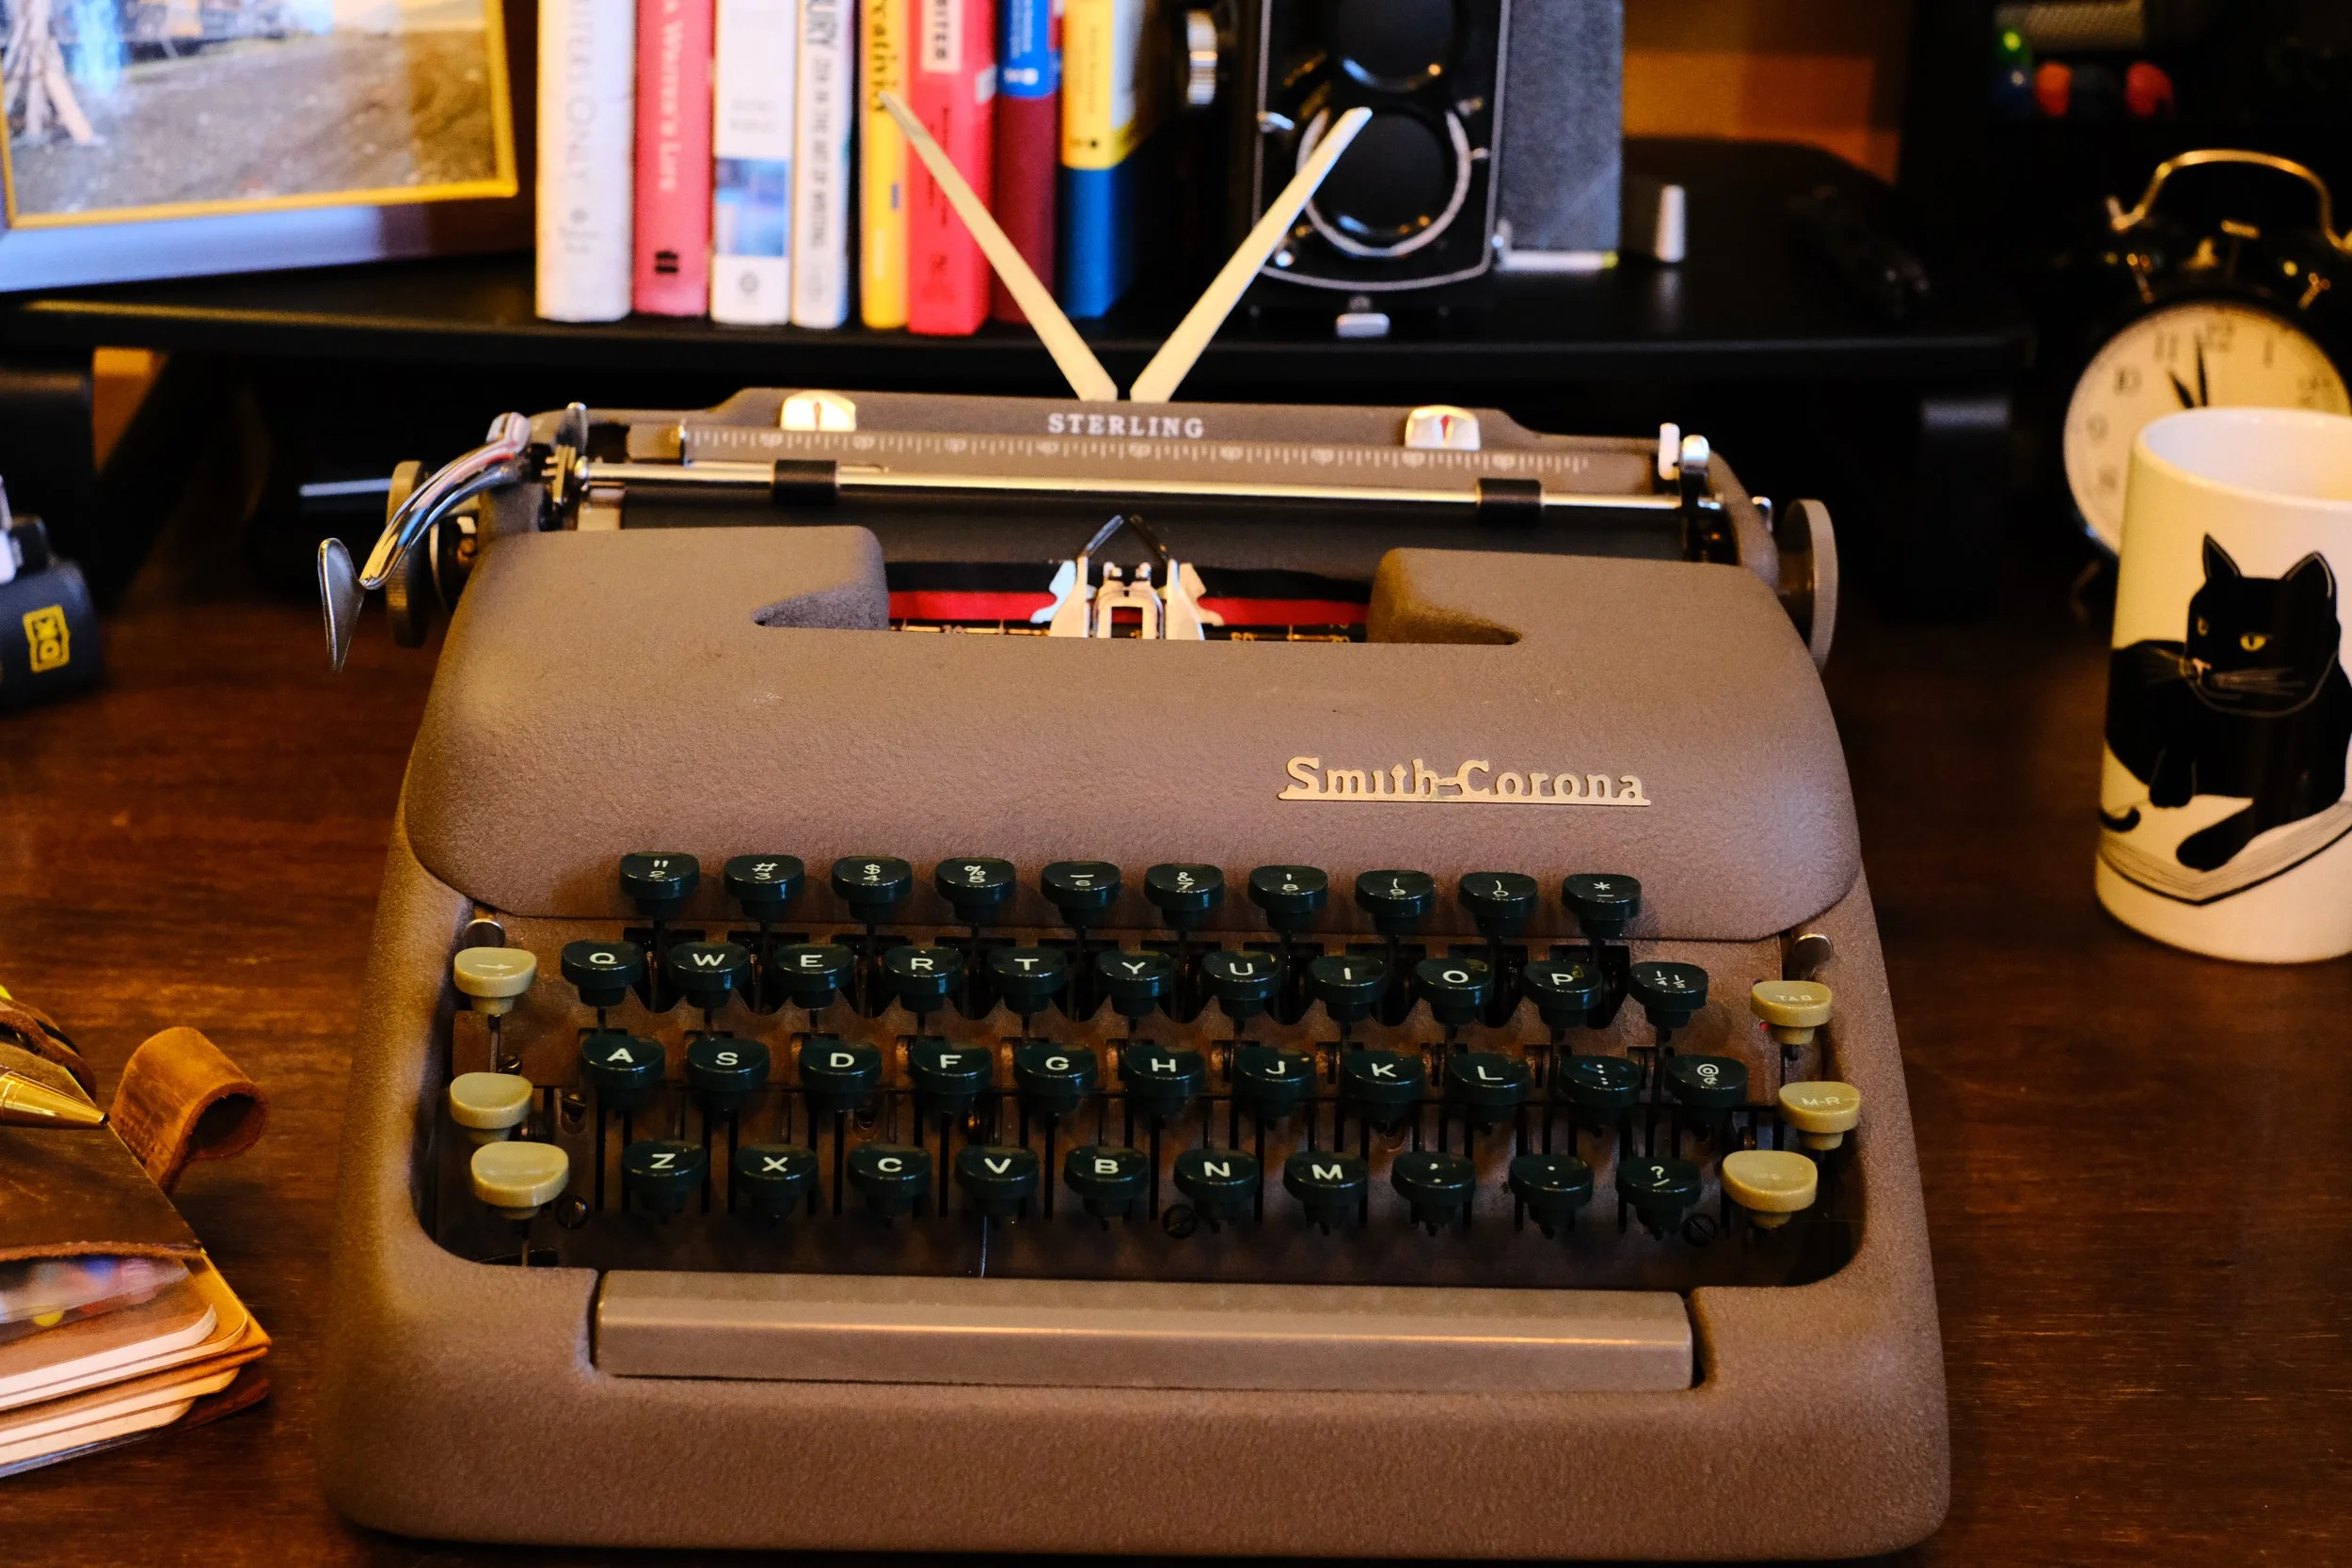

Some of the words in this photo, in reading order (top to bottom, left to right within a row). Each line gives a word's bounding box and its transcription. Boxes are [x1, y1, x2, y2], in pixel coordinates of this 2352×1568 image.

[1048, 412, 1205, 439] STERLING
[1279, 756, 1651, 806] Smith-Corona
[589, 952, 617, 965] Q
[692, 952, 725, 968] W
[800, 954, 824, 968] E
[911, 958, 934, 971] R
[1013, 958, 1040, 972] T
[1121, 961, 1146, 975] Y
[1229, 962, 1254, 976] U
[1343, 967, 1352, 980] I
[1442, 970, 1469, 984] O
[1550, 972, 1575, 986] P
[607, 1047, 634, 1063] A
[715, 1052, 739, 1066] S
[830, 1052, 854, 1069] D
[940, 1053, 962, 1069] F
[1045, 1056, 1070, 1070] G
[1151, 1057, 1177, 1072] H
[1264, 1060, 1286, 1075] J
[1371, 1063, 1397, 1078] K
[1477, 1065, 1503, 1081] L
[1696, 1063, 1720, 1078] @
[650, 1152, 676, 1169] Z
[762, 1156, 788, 1172] X
[878, 1157, 902, 1173] C
[984, 1157, 1011, 1174] V
[1093, 1158, 1119, 1175] B
[1203, 1161, 1231, 1178] N
[1311, 1164, 1343, 1180] M
